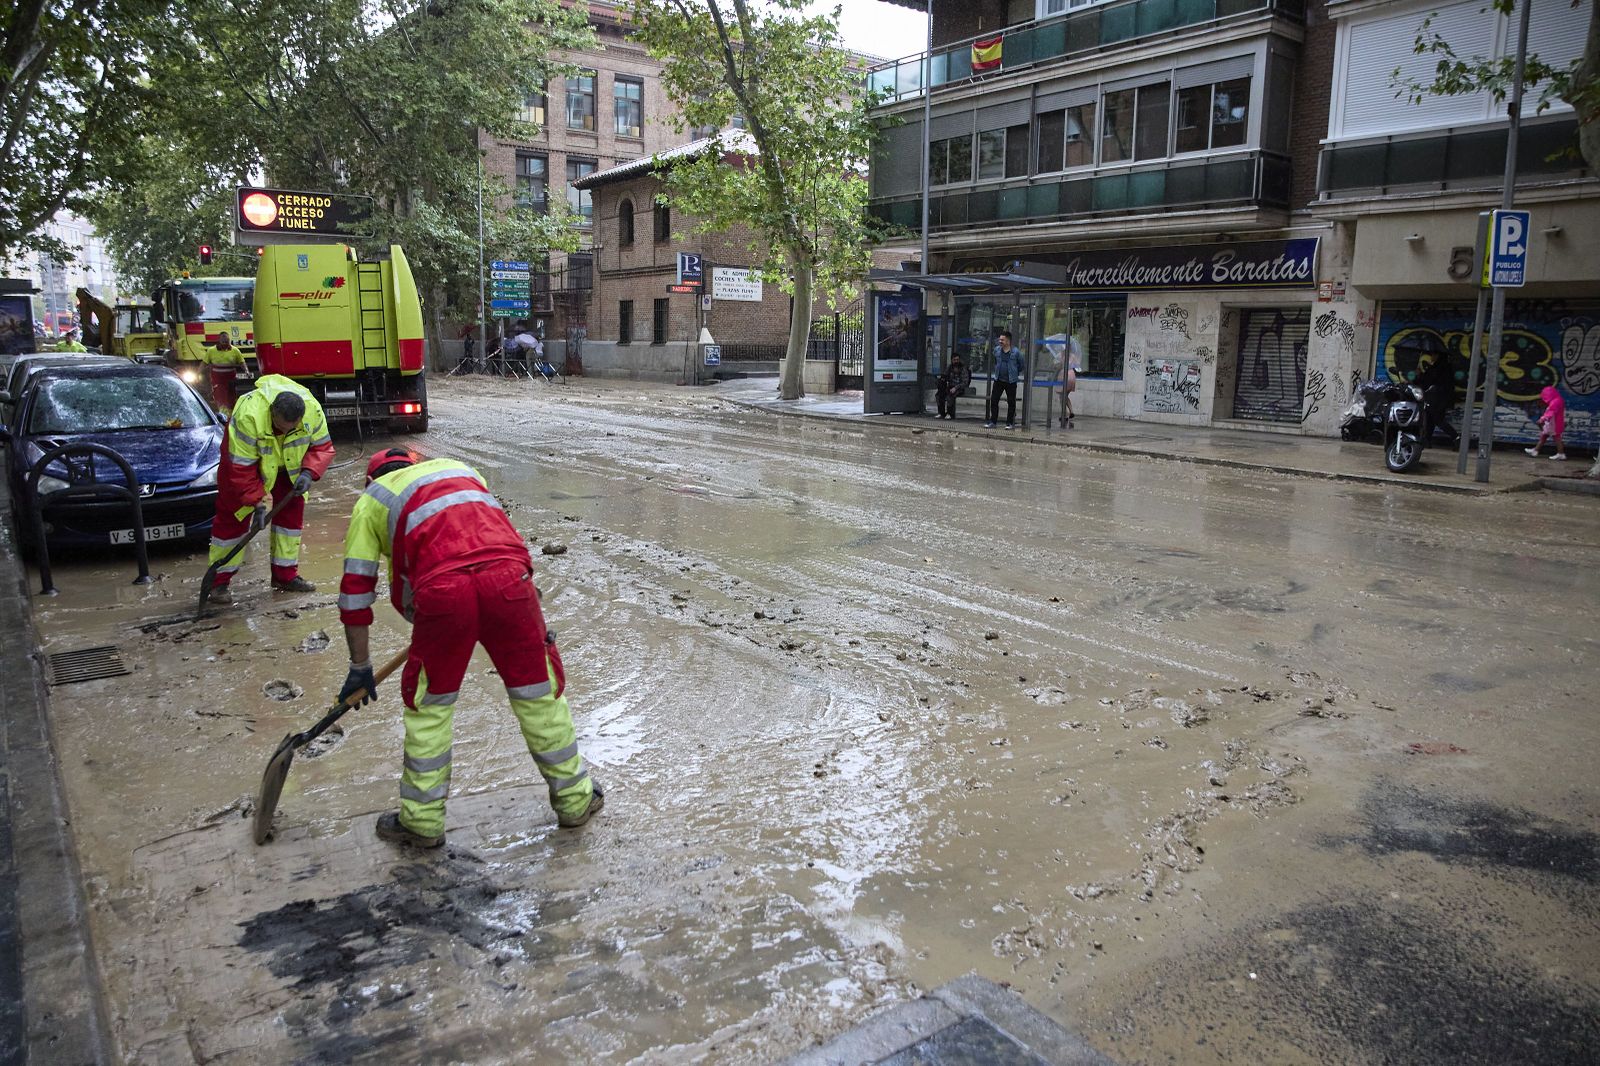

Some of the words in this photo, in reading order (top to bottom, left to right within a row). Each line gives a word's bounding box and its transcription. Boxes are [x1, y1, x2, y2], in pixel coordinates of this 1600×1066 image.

[278, 195, 331, 207] CERRADO
[278, 207, 324, 218] ACCESO
[279, 218, 316, 229] TUNEL
[1499, 219, 1522, 255] P
[682, 254, 699, 272] P
[1066, 255, 1204, 286] Increiblemente
[1211, 249, 1310, 283] Baratas
[280, 290, 335, 299] selur
